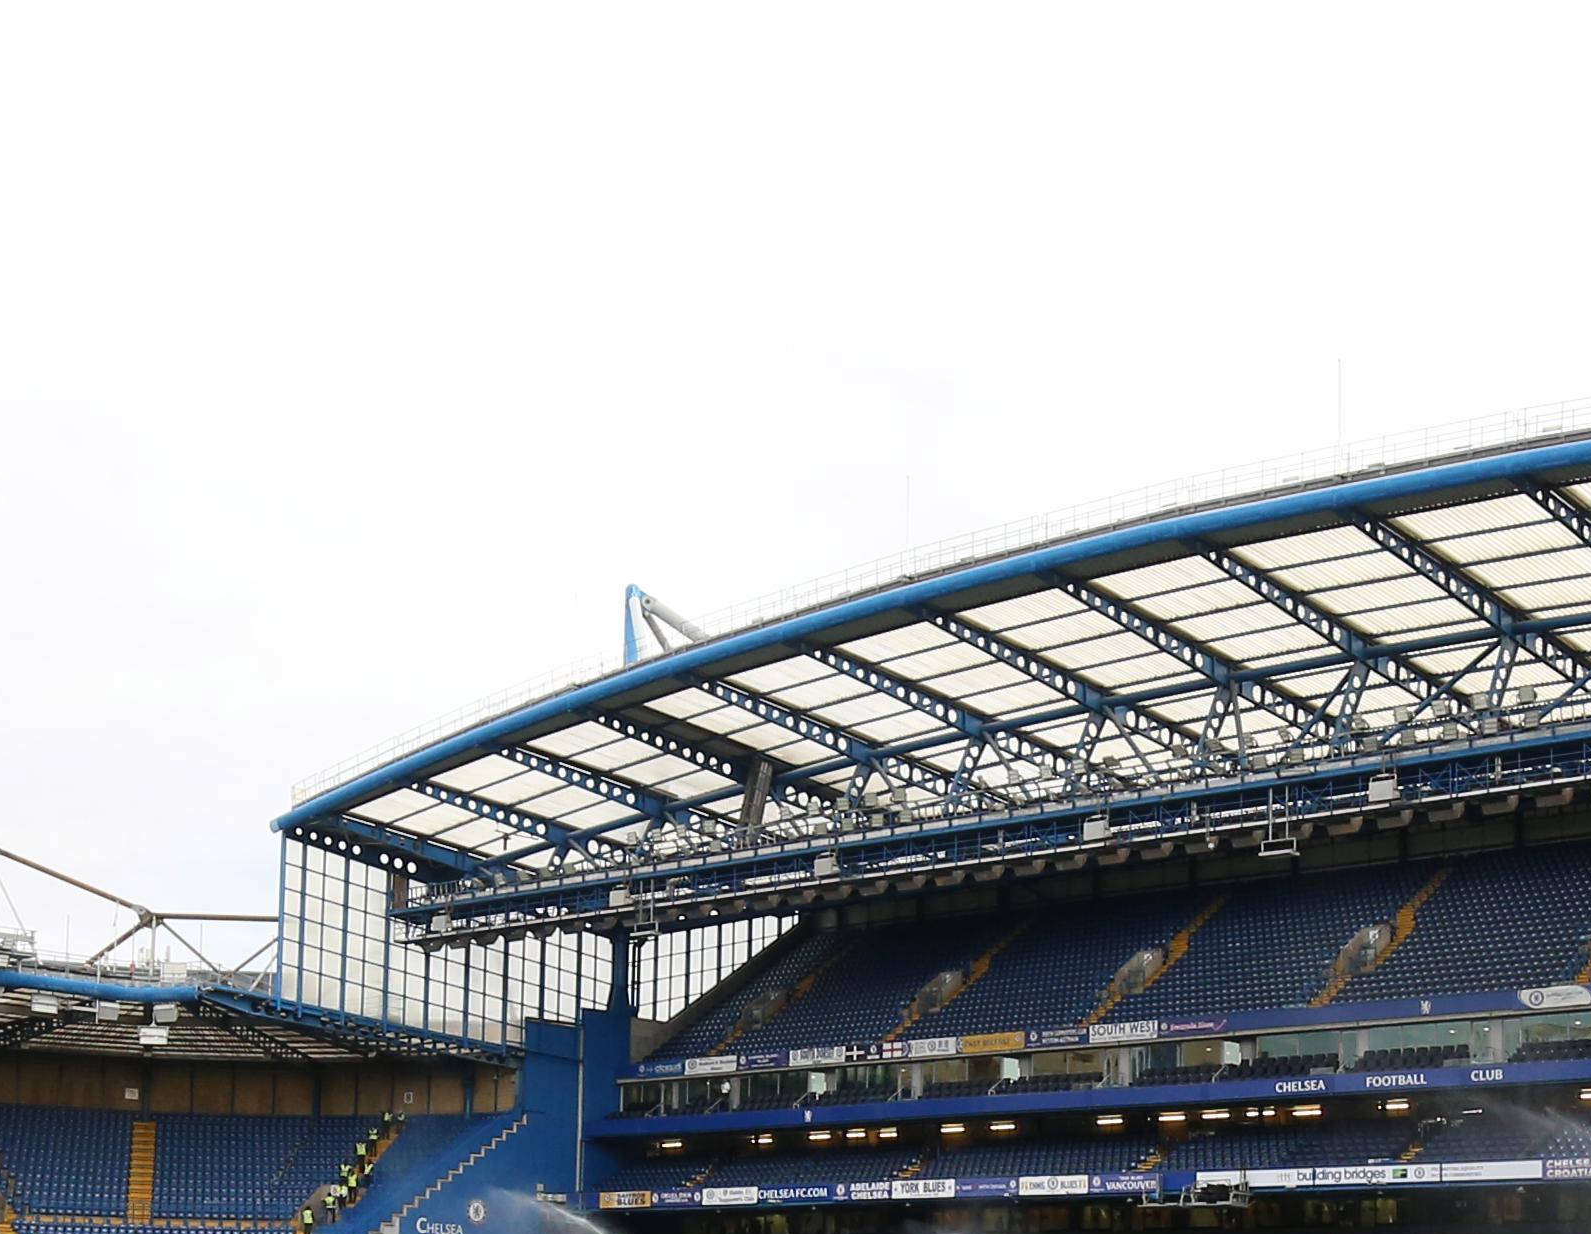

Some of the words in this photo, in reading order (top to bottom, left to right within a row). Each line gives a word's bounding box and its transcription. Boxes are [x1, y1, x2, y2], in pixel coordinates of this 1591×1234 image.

[1091, 1023, 1125, 1037] SOUTH
[1129, 1020, 1156, 1033] WEST
[1275, 1079, 1325, 1093] CHELSEA
[1366, 1074, 1427, 1087] FOOTBALL
[1471, 1069, 1503, 1082] CLUB
[1297, 1169, 1341, 1184] building
[1344, 1167, 1387, 1182] bridges
[850, 1181, 890, 1192] ADELAIDE
[900, 1182, 919, 1194] YORK
[923, 1181, 946, 1193] BLUES
[851, 1190, 888, 1200] CHELSEA
